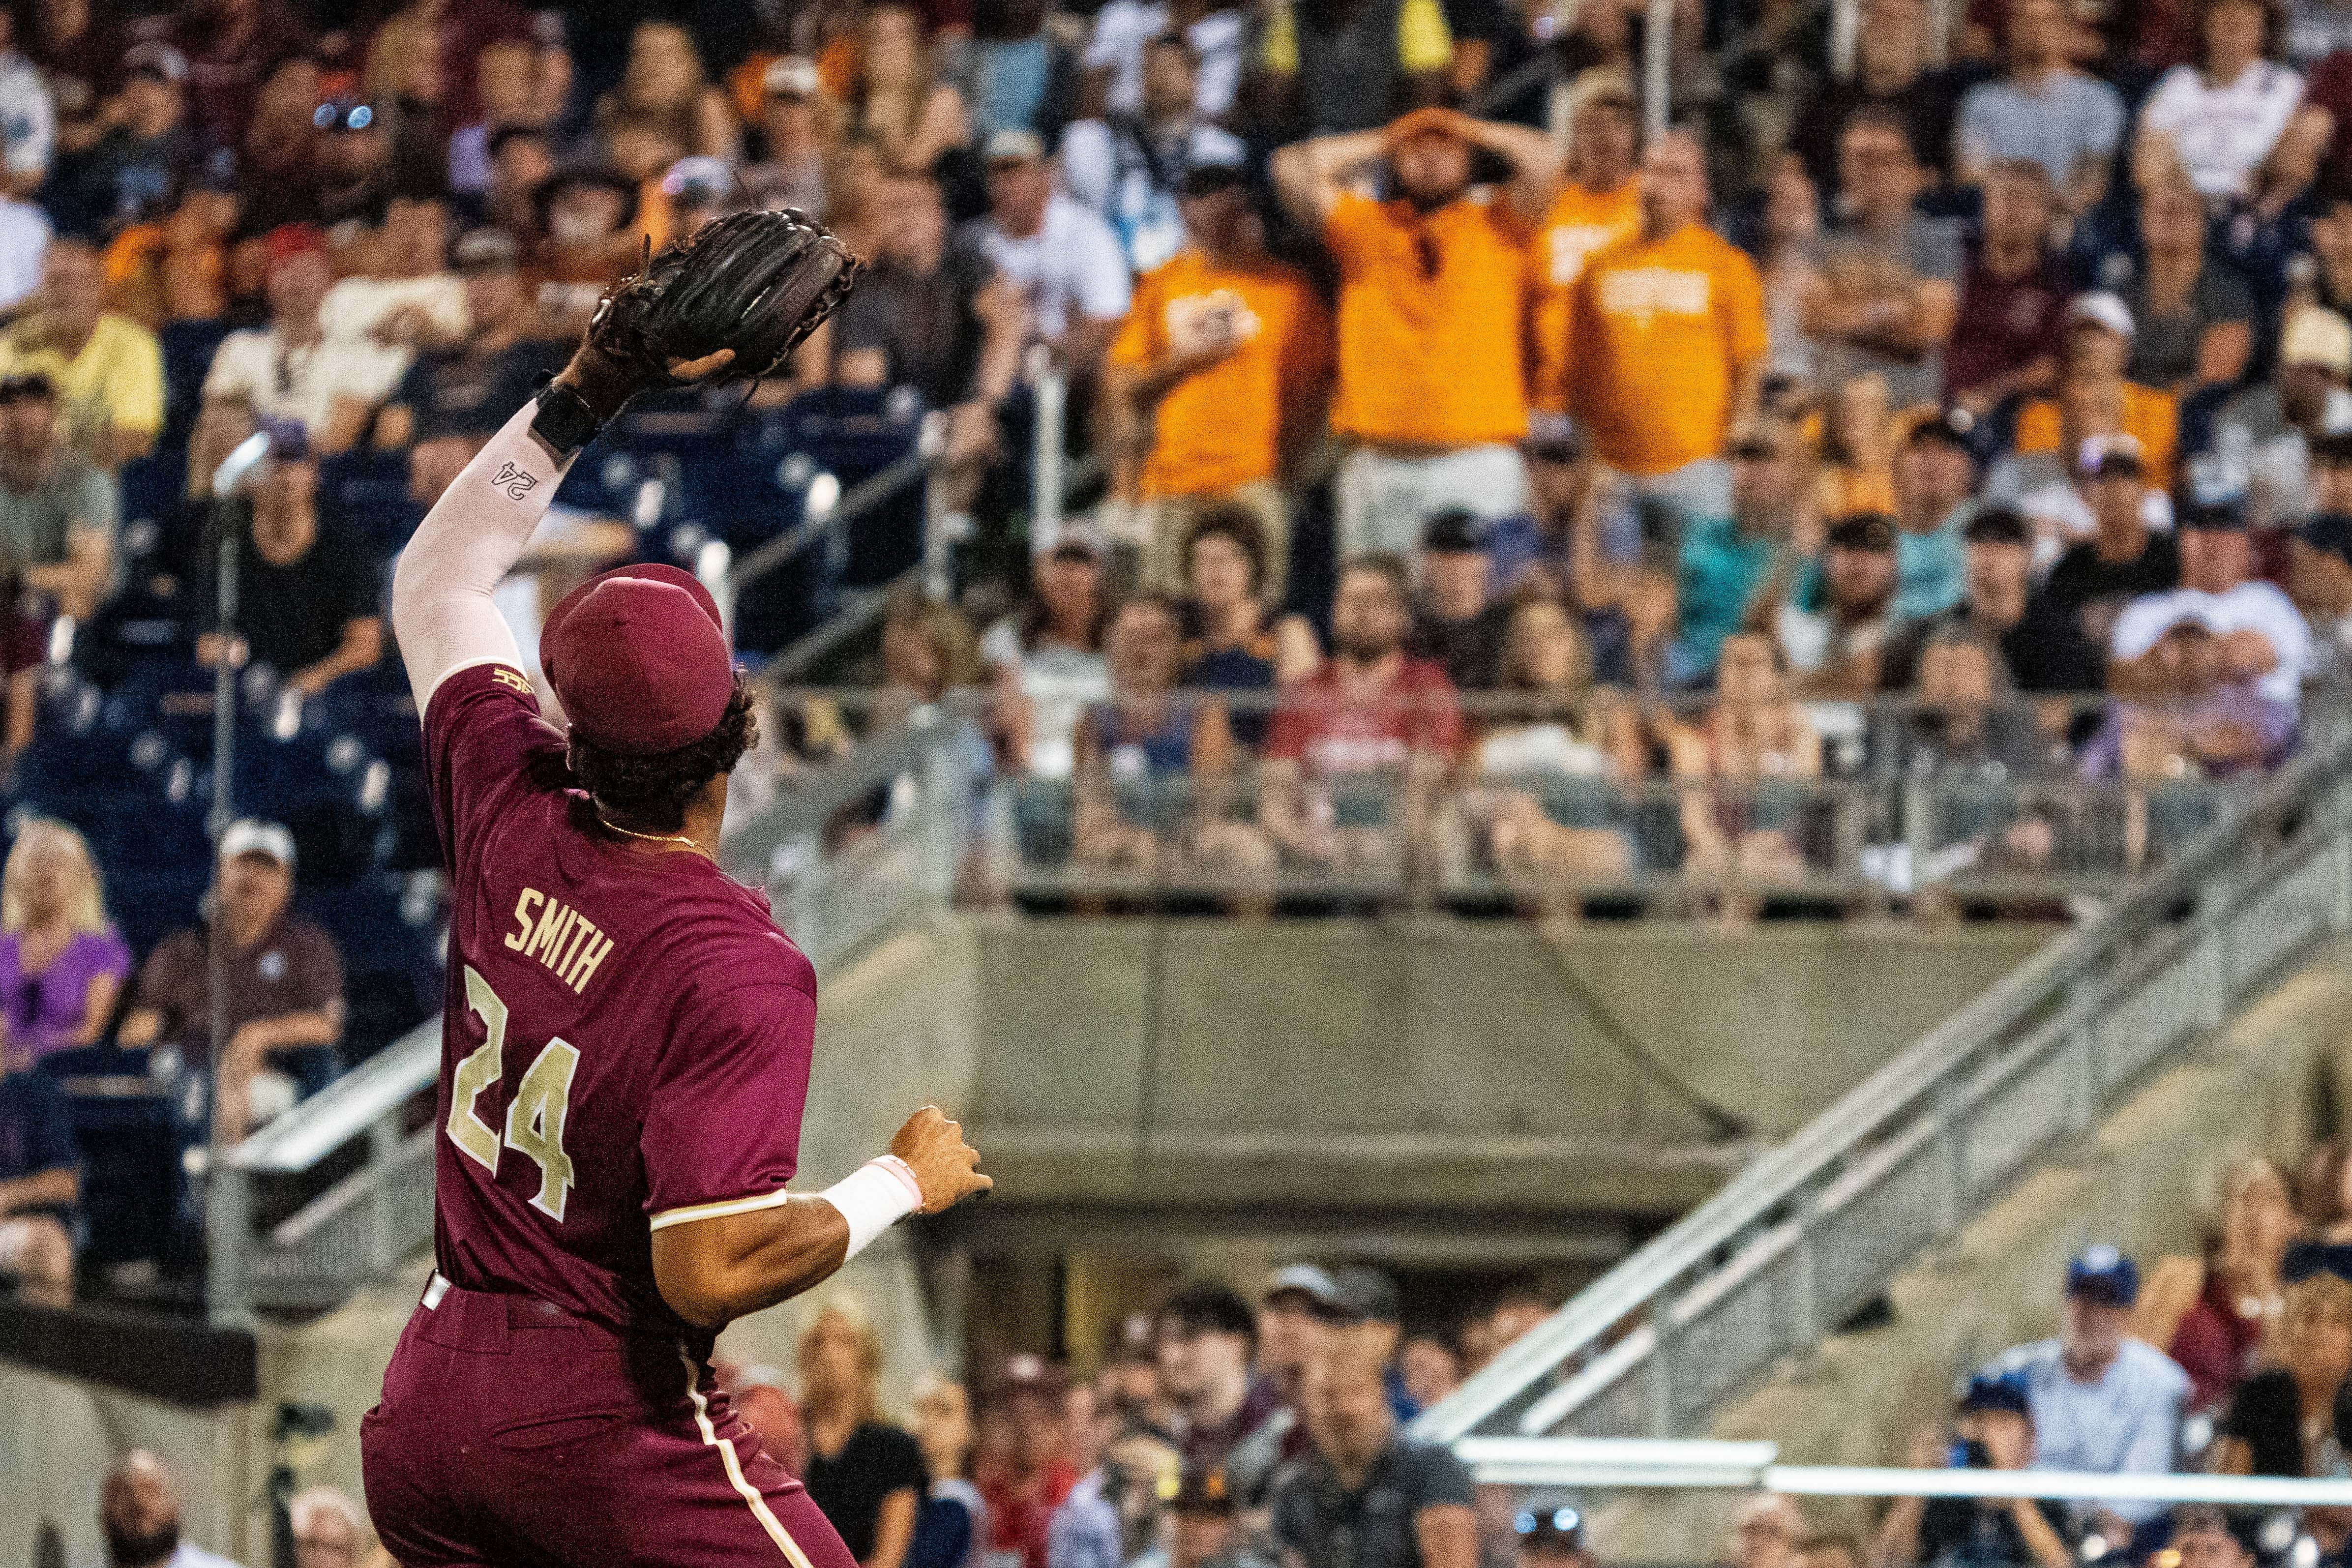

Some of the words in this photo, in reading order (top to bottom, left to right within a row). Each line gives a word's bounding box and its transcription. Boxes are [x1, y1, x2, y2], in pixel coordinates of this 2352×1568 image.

[491, 461, 537, 501] 24
[505, 887, 614, 995] SMITH
[446, 965, 581, 1223] 24
